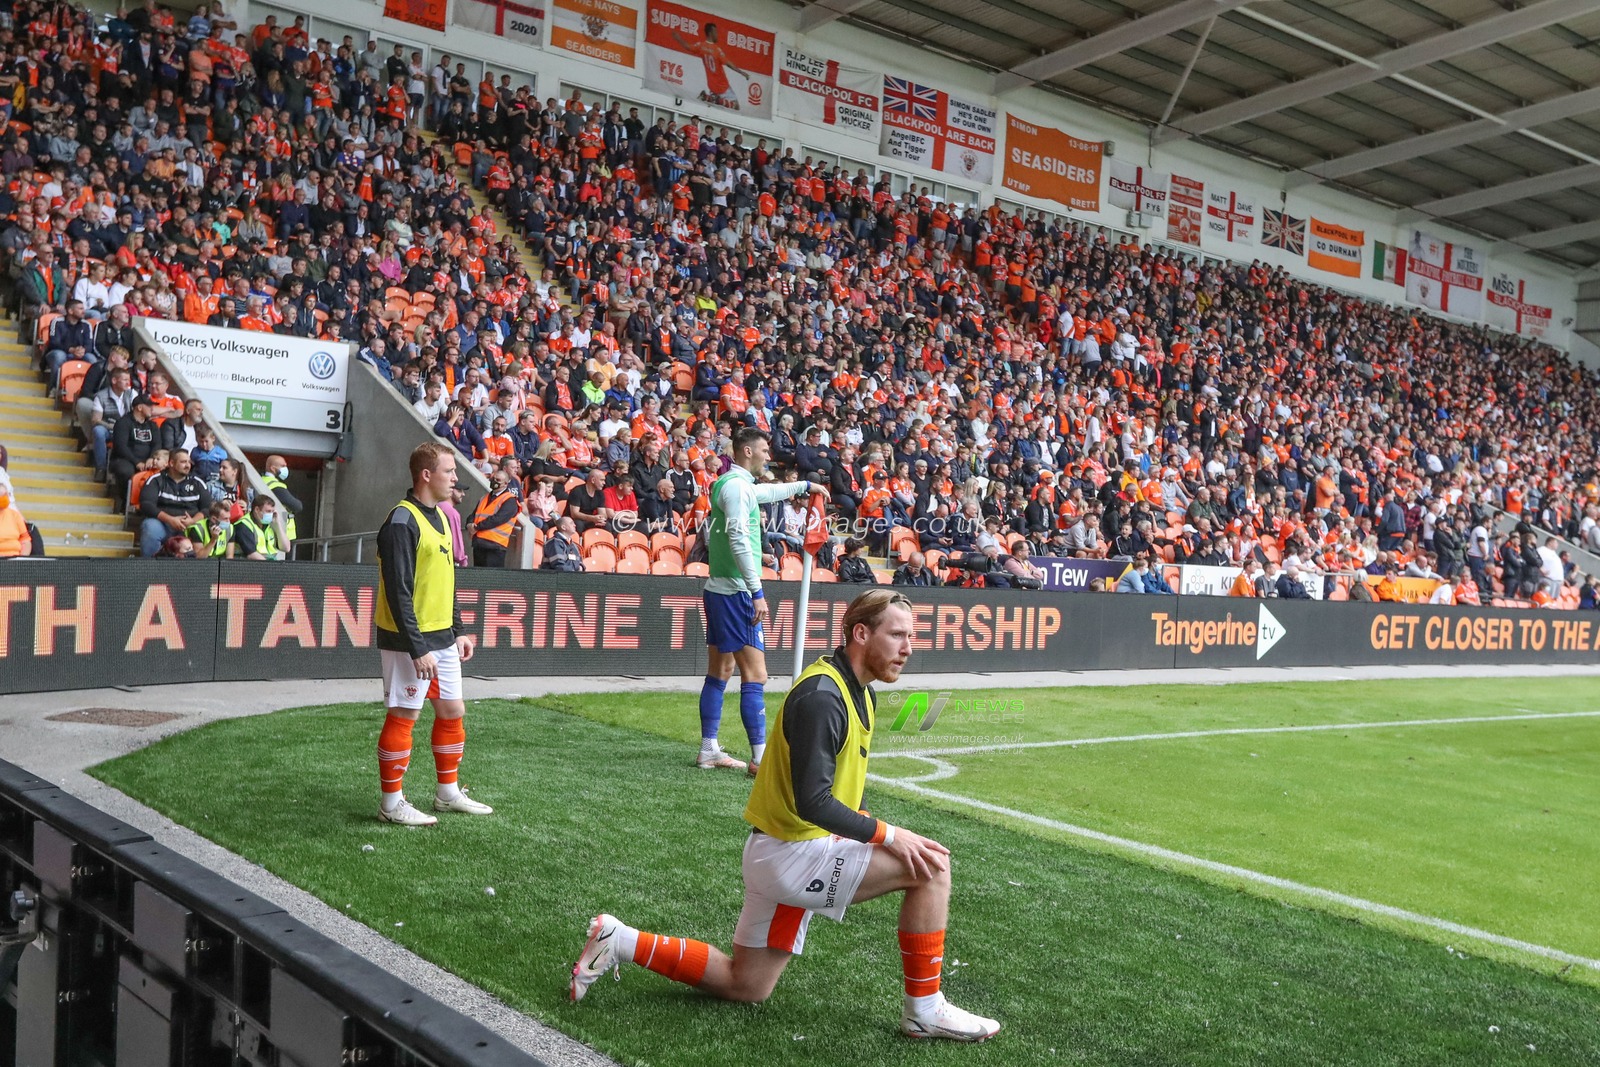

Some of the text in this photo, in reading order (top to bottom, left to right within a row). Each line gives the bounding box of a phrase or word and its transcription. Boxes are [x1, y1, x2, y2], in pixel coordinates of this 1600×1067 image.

[594, 1, 621, 15] NAYS
[510, 20, 537, 36] 2020
[651, 8, 699, 36] SUPER
[566, 40, 622, 63] SEASIDERS
[727, 31, 770, 55] BRETT
[660, 59, 684, 78] FY6
[786, 59, 823, 77] HINDLEY
[809, 58, 824, 68] LEE
[788, 75, 873, 107] BLACKPOOL FC
[838, 106, 874, 122] ORIGINAL
[949, 99, 996, 119] SIMON SADLER
[958, 111, 987, 124] HE'S ONE
[841, 116, 871, 131] MUCKER
[883, 111, 995, 151] BLACKPOOL ARE BACK
[962, 120, 976, 129] OUR
[978, 124, 992, 133] OWN
[1011, 119, 1038, 136] SIMON
[888, 138, 926, 154] And Tigger
[891, 130, 925, 145] AngelBFC
[892, 148, 920, 161] On Tour
[1011, 147, 1095, 184] SEASIDERS
[1007, 177, 1031, 192] UTMP
[1111, 179, 1165, 200] BLACKPOOL FC
[1070, 197, 1097, 209] BRETT
[1210, 193, 1227, 204] MATT
[1237, 202, 1253, 213] DAVE
[1208, 221, 1226, 232] NOSH
[1316, 225, 1348, 240] BLACKPOOL
[1316, 241, 1358, 258] CO DURHAM
[1492, 276, 1515, 295] MSG
[154, 331, 290, 360] Lookers Volkswagen
[185, 369, 218, 381] supplier
[221, 372, 230, 381] to
[231, 373, 275, 386] Blackpool
[276, 378, 288, 387] FC
[302, 382, 341, 393] Volkswagen
[252, 402, 268, 411] Fire
[252, 411, 267, 420] exit
[325, 409, 341, 429] 3
[1052, 562, 1089, 587] Tew
[125, 583, 185, 652] A
[1151, 611, 1276, 654] Tangerine tv
[1370, 614, 1420, 650] GET
[1424, 615, 1514, 651] CLOSER
[1519, 618, 1547, 651] TO
[1552, 620, 1591, 650] THE
[823, 857, 845, 908] bartercard
